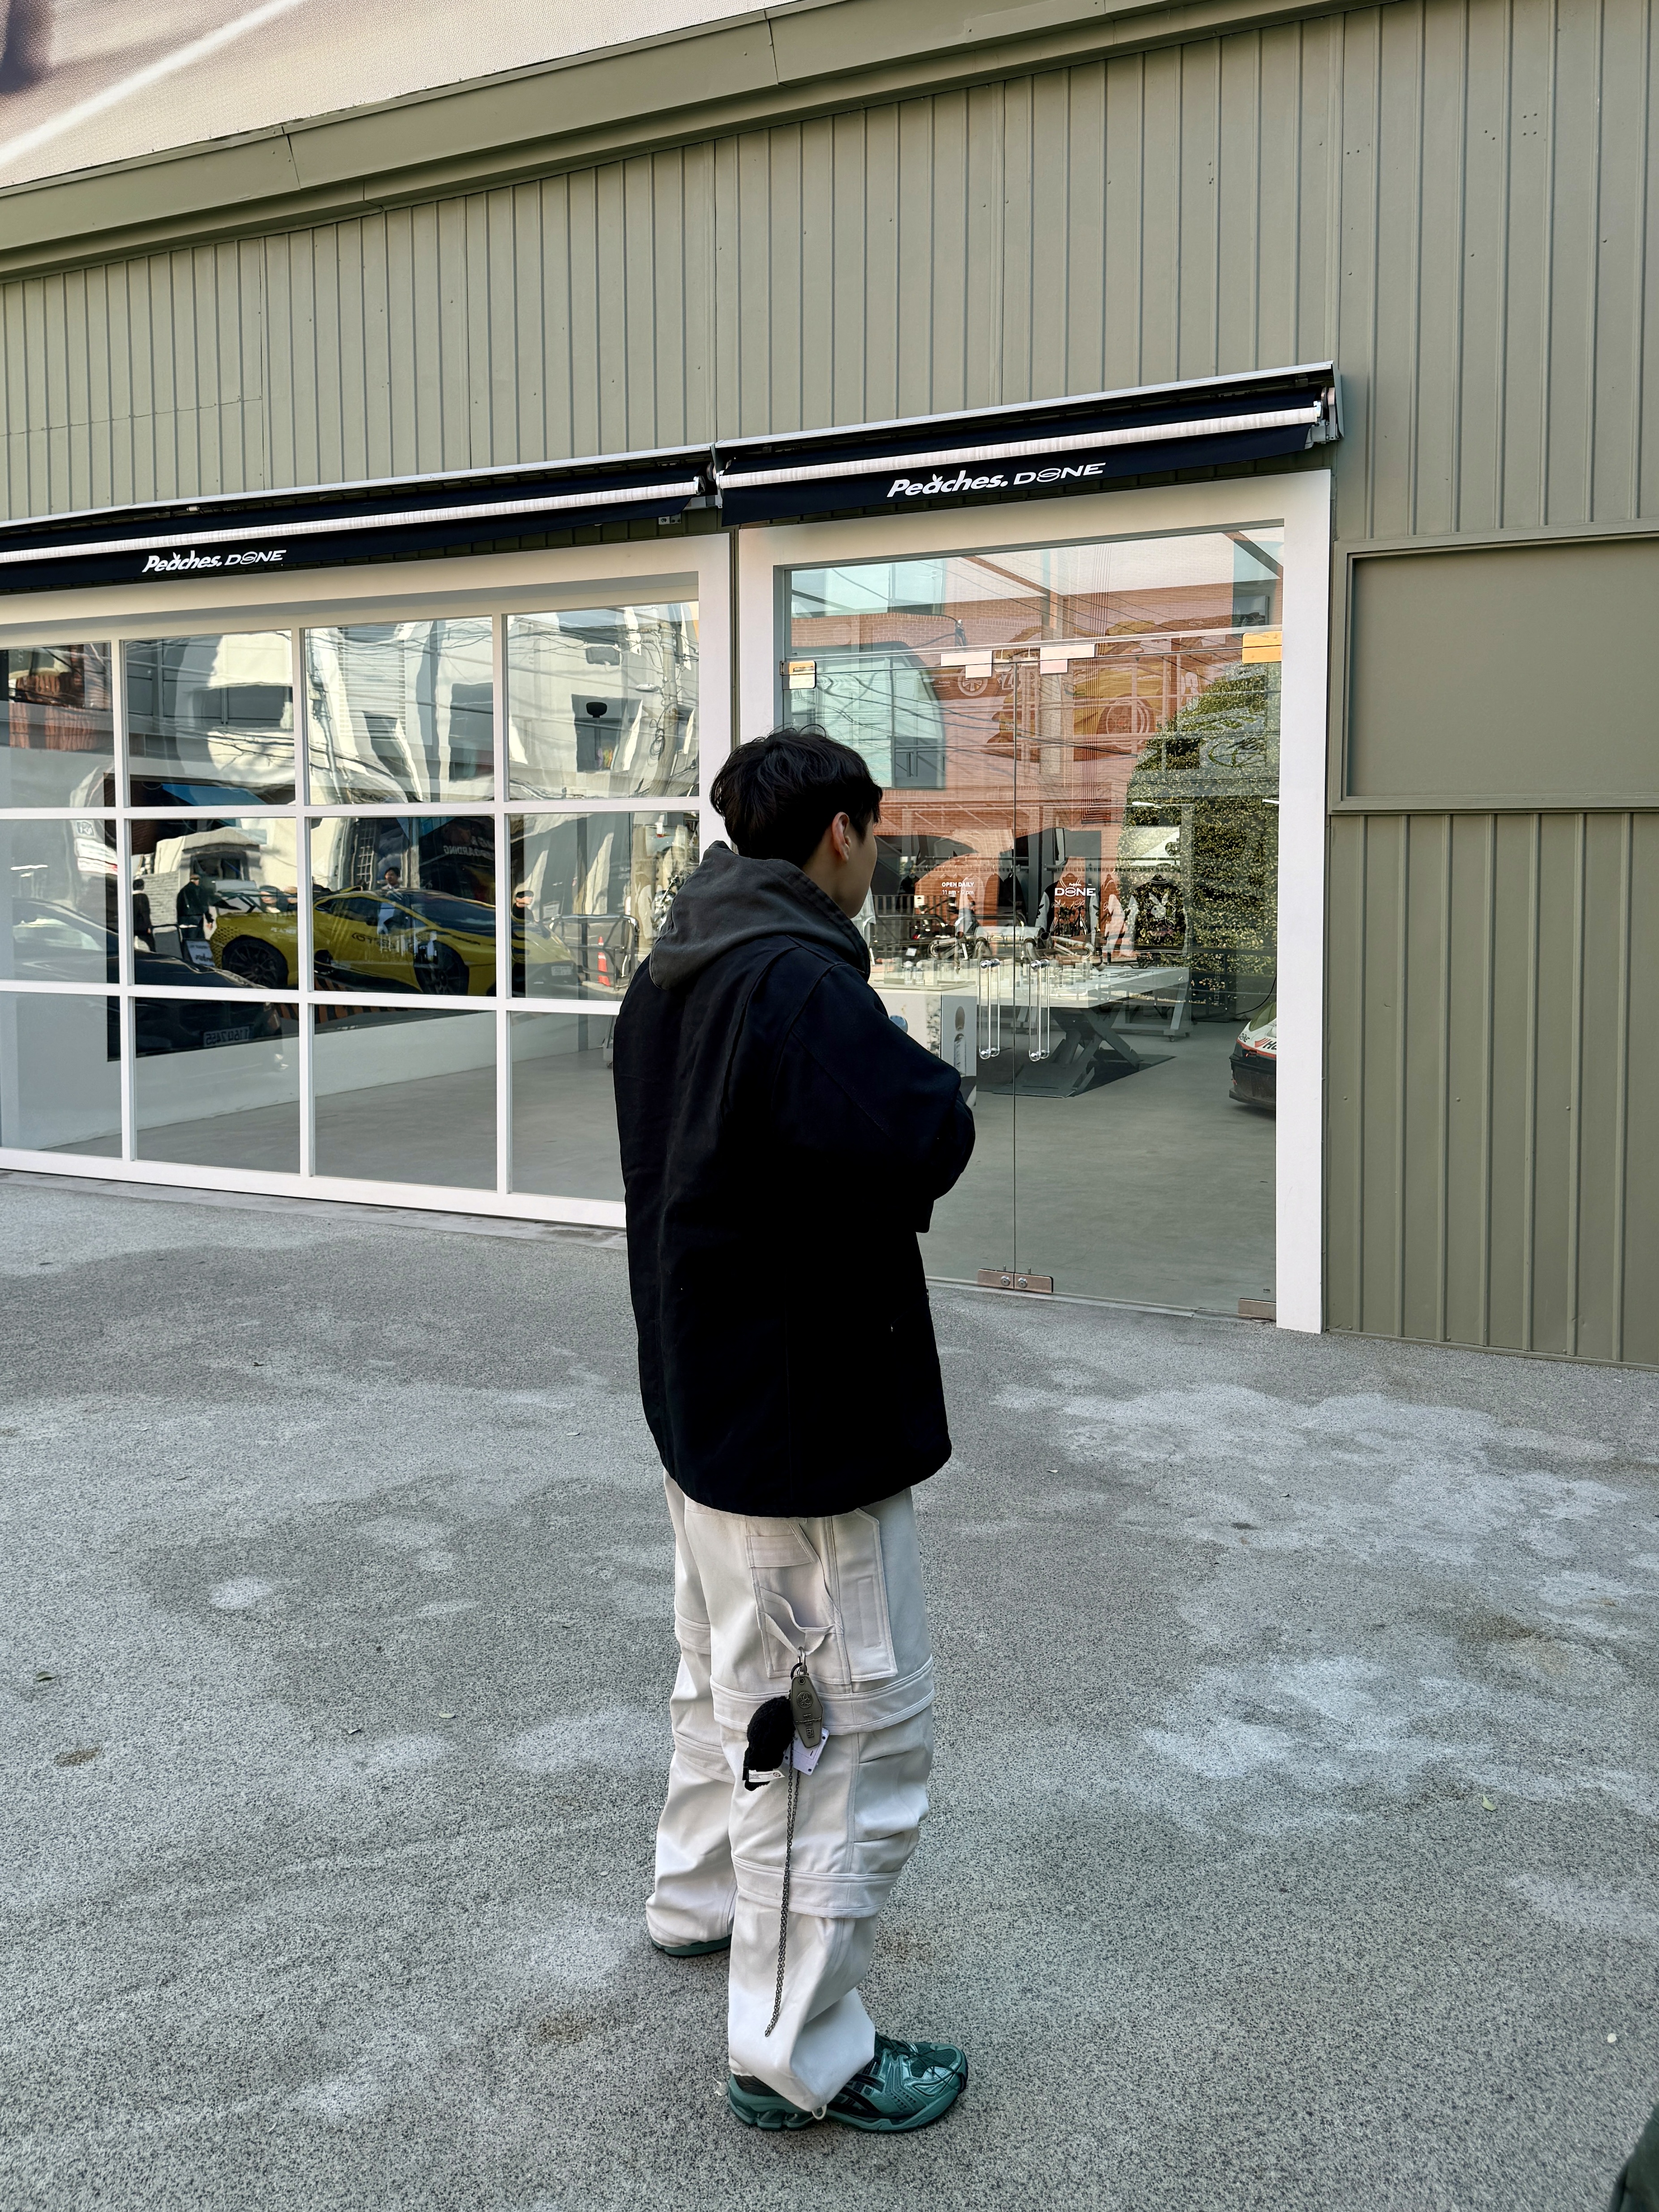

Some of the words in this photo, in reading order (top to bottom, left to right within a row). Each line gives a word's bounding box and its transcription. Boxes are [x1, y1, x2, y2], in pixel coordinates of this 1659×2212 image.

[886, 470, 1009, 498] Peaches.
[1013, 462, 1106, 485] DONE
[142, 550, 223, 573] Peaches.
[224, 550, 287, 566] DONE
[1055, 887, 1096, 897] DONE
